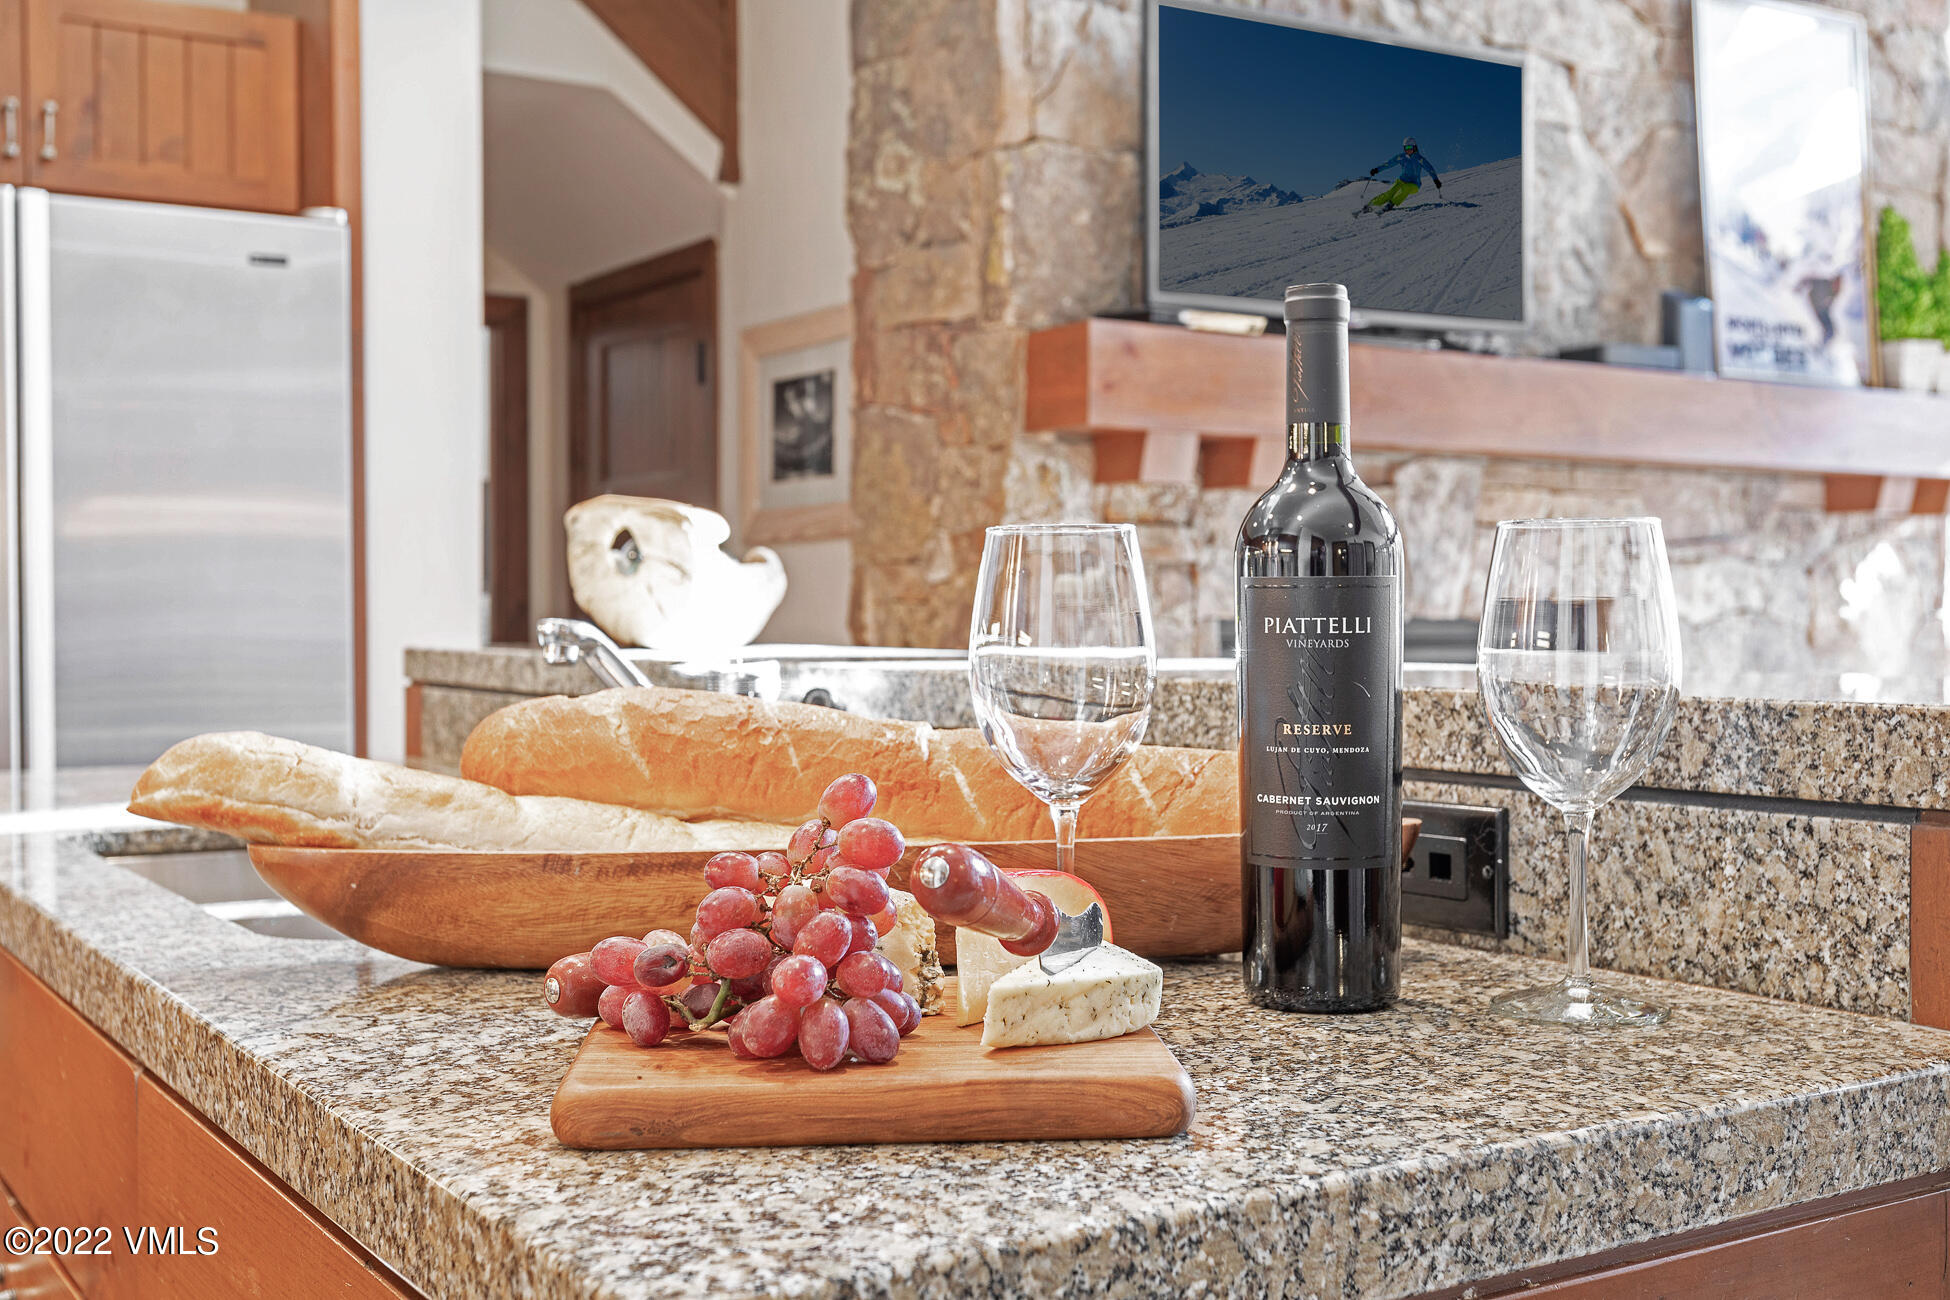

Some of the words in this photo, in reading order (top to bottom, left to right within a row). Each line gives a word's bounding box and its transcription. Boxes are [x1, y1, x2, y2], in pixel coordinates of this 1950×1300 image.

[1264, 617, 1371, 634] PIATTELLI
[1286, 639, 1350, 648] VINEYARDS
[1283, 724, 1352, 735] RESERVE
[1257, 794, 1311, 805] CABERNET
[1316, 795, 1380, 805] SAUVIGNON
[1306, 823, 1328, 833] 2017
